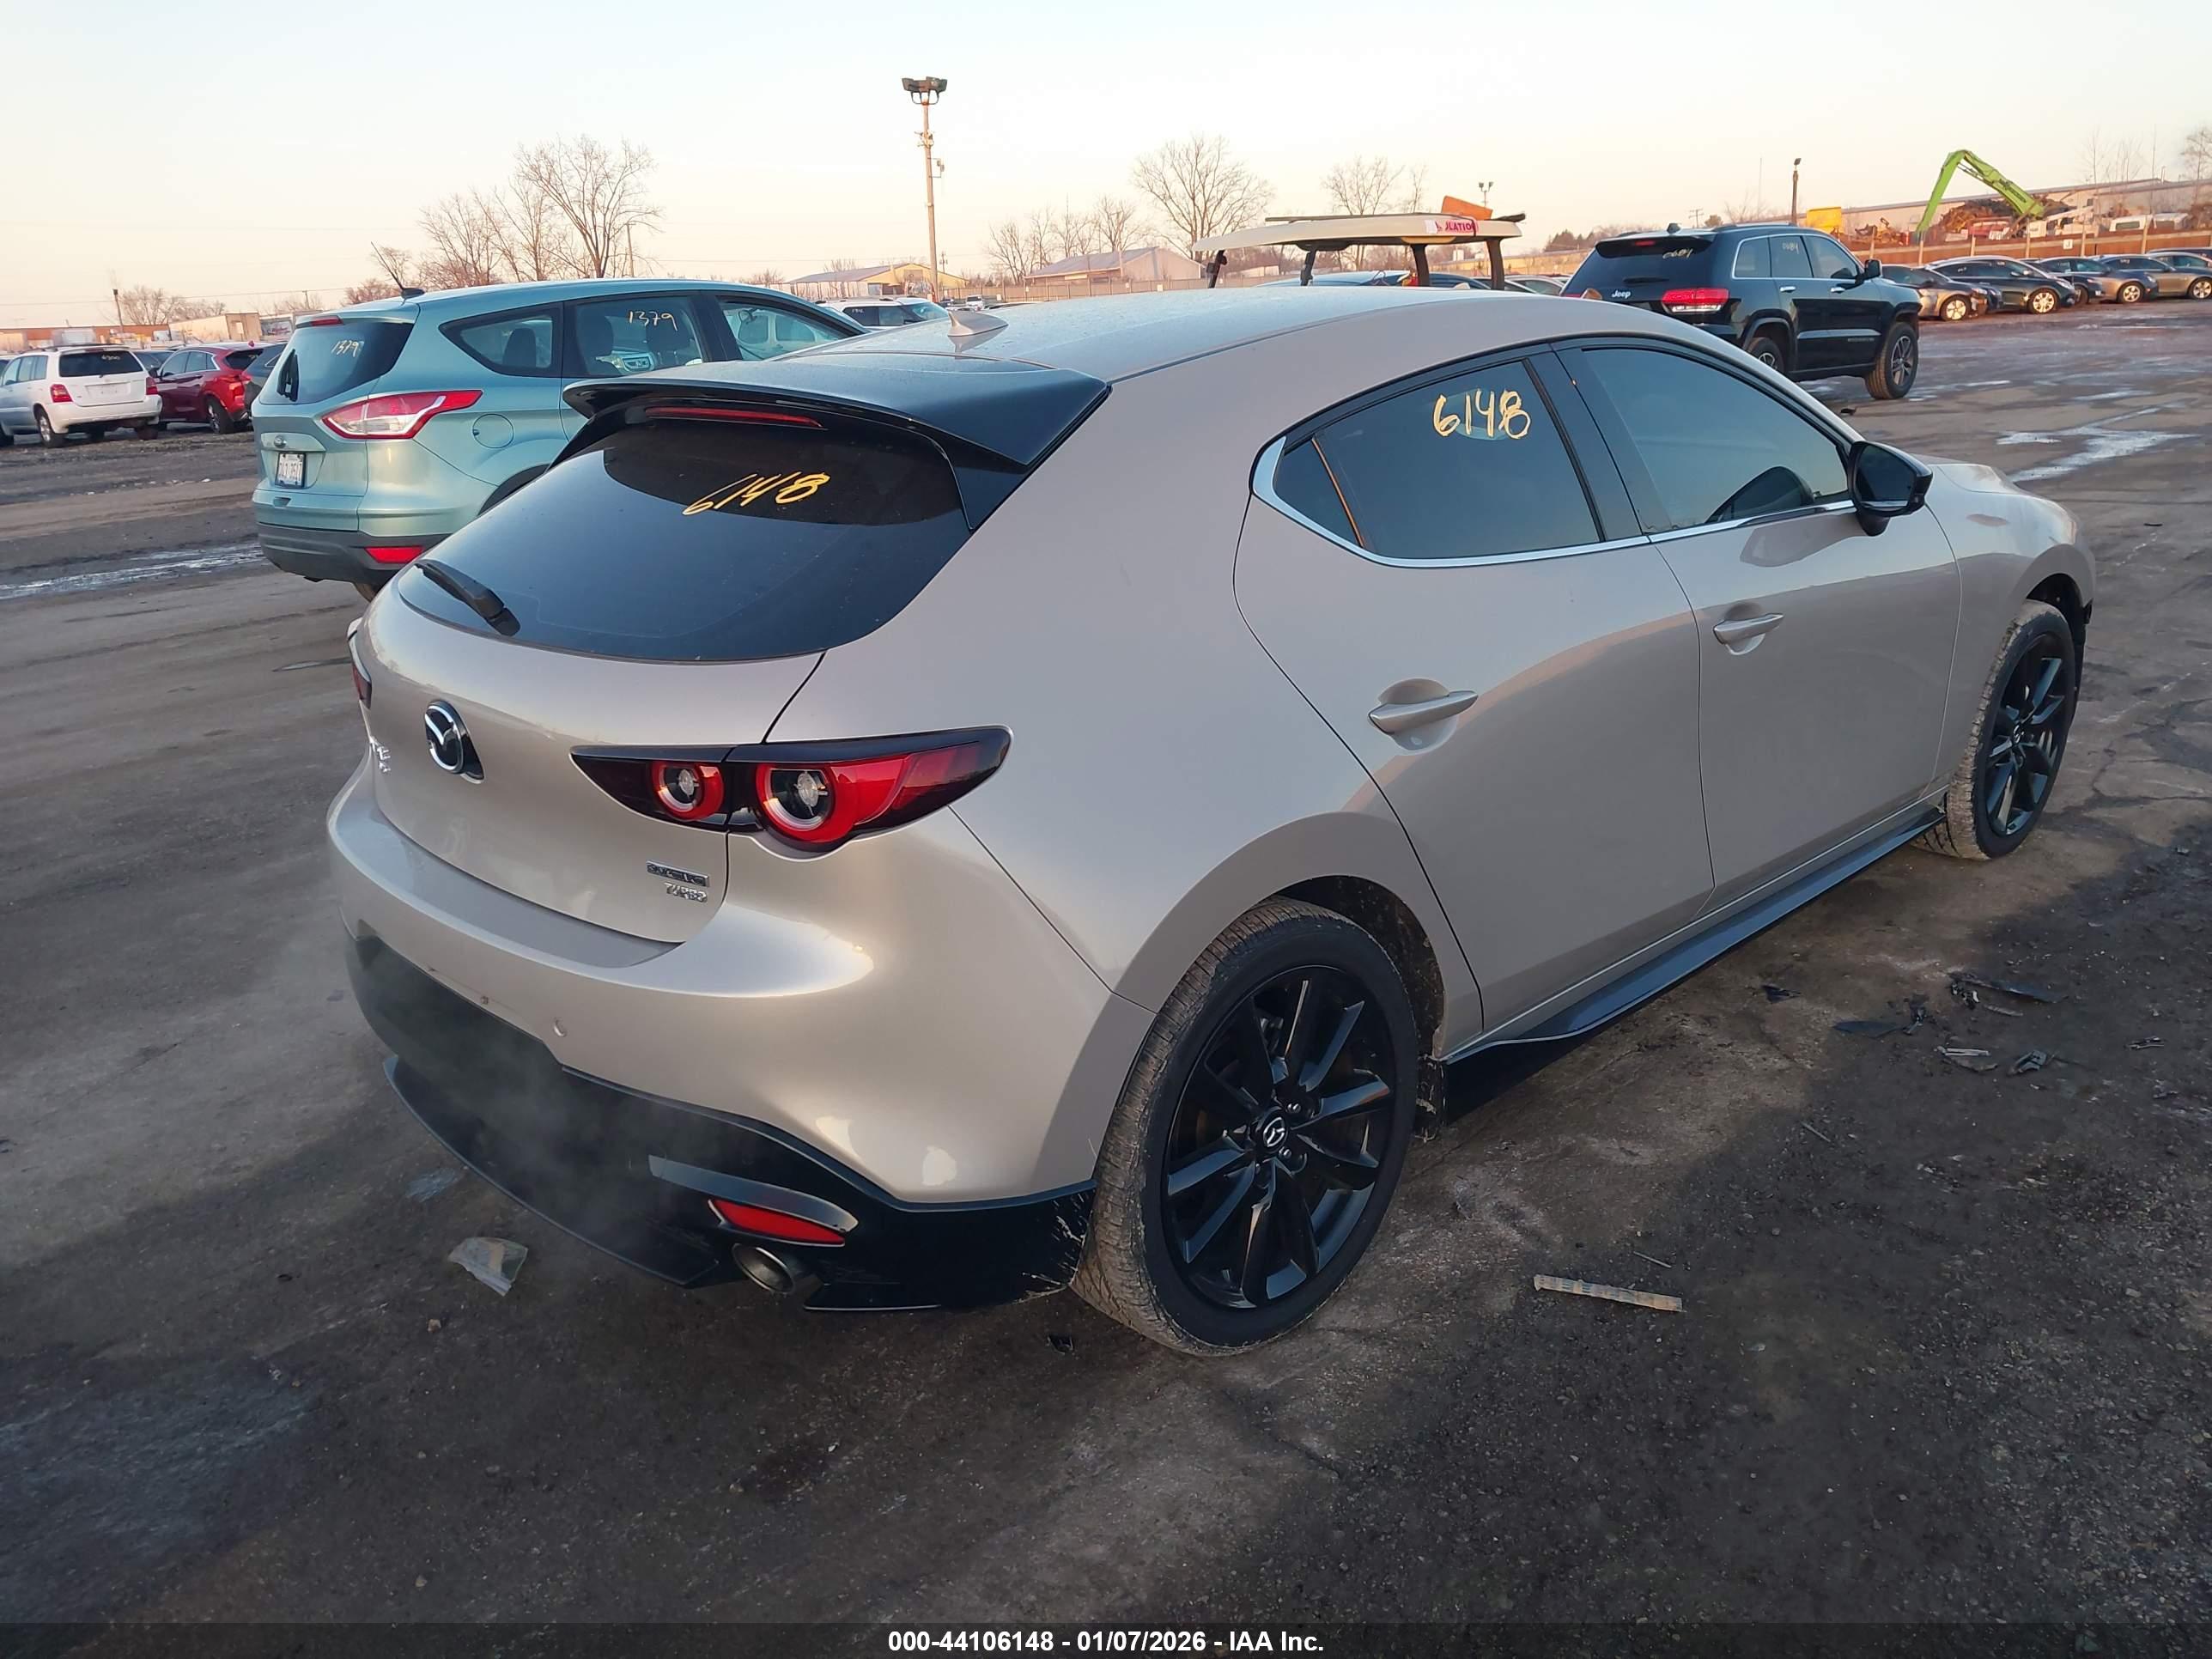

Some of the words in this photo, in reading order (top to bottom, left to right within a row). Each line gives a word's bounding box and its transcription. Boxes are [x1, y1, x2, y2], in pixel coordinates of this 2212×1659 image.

[1612, 289, 1632, 299] Jeep
[629, 310, 678, 331] 1379
[1432, 388, 1531, 439] 6148
[682, 471, 831, 515] 6148
